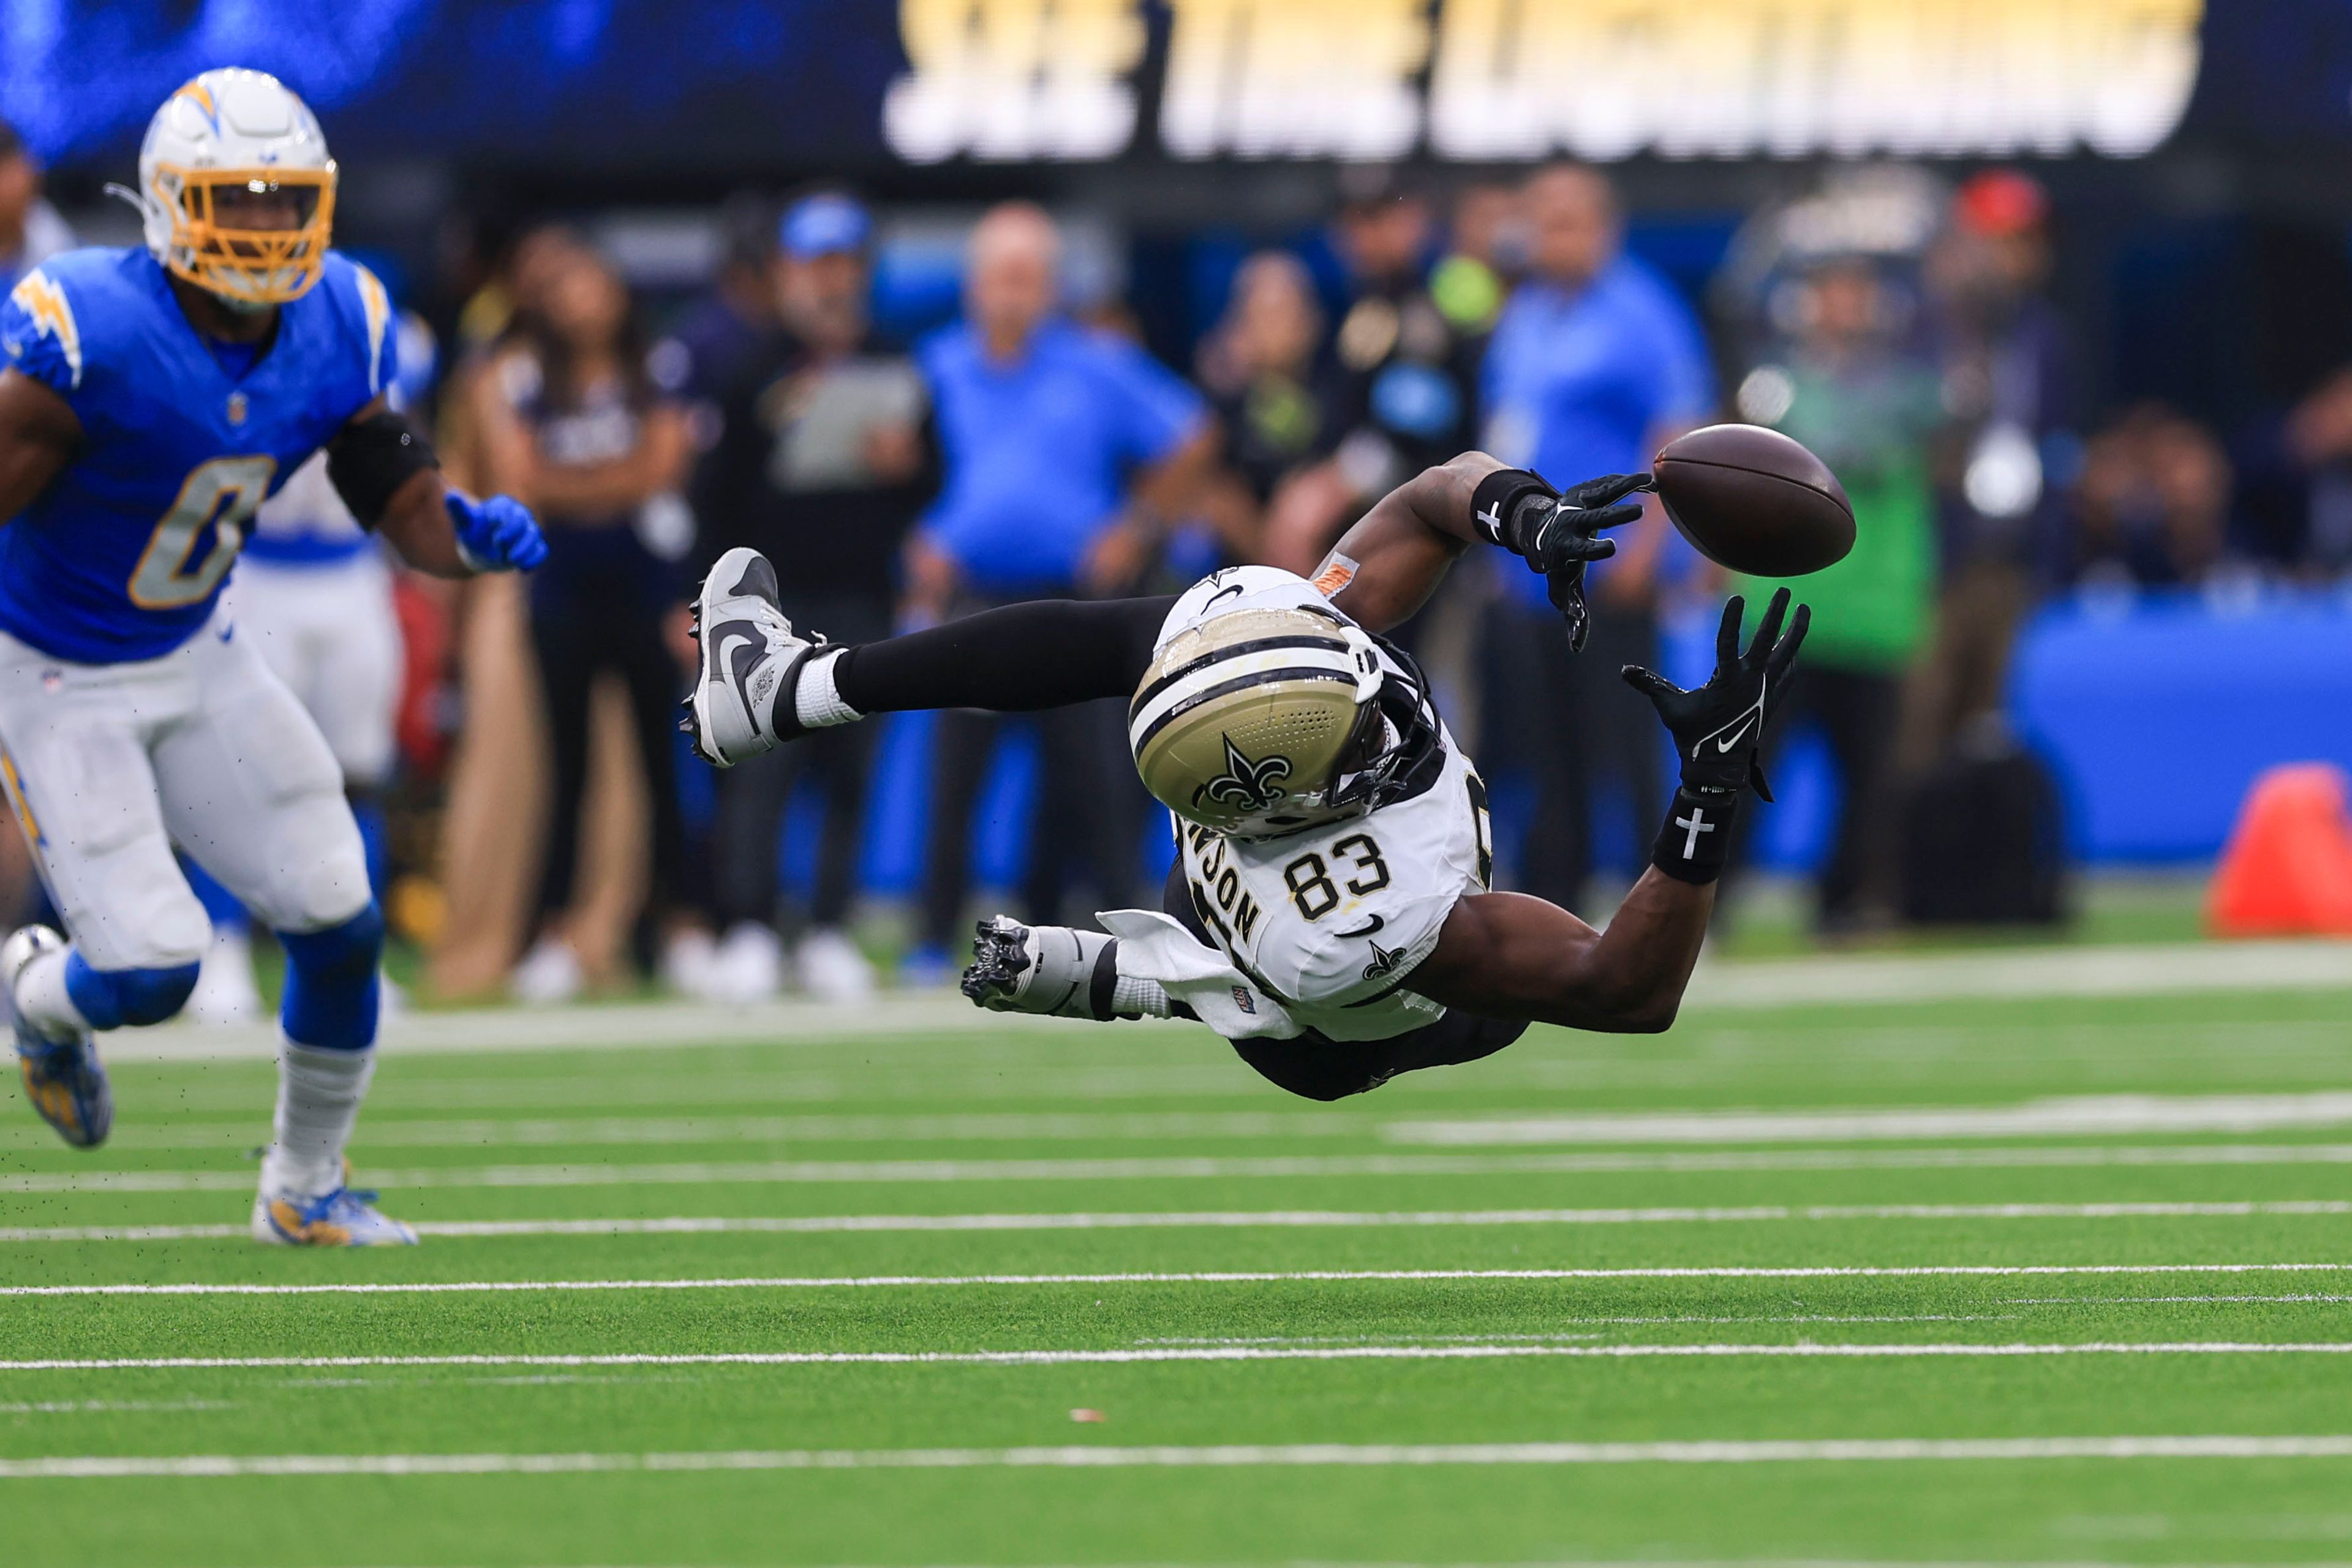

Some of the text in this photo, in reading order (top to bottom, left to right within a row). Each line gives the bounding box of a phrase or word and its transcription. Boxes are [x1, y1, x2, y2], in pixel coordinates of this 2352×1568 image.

[127, 454, 277, 610] 0
[1187, 822, 1262, 948] NSON
[1284, 833, 1392, 924] 83
